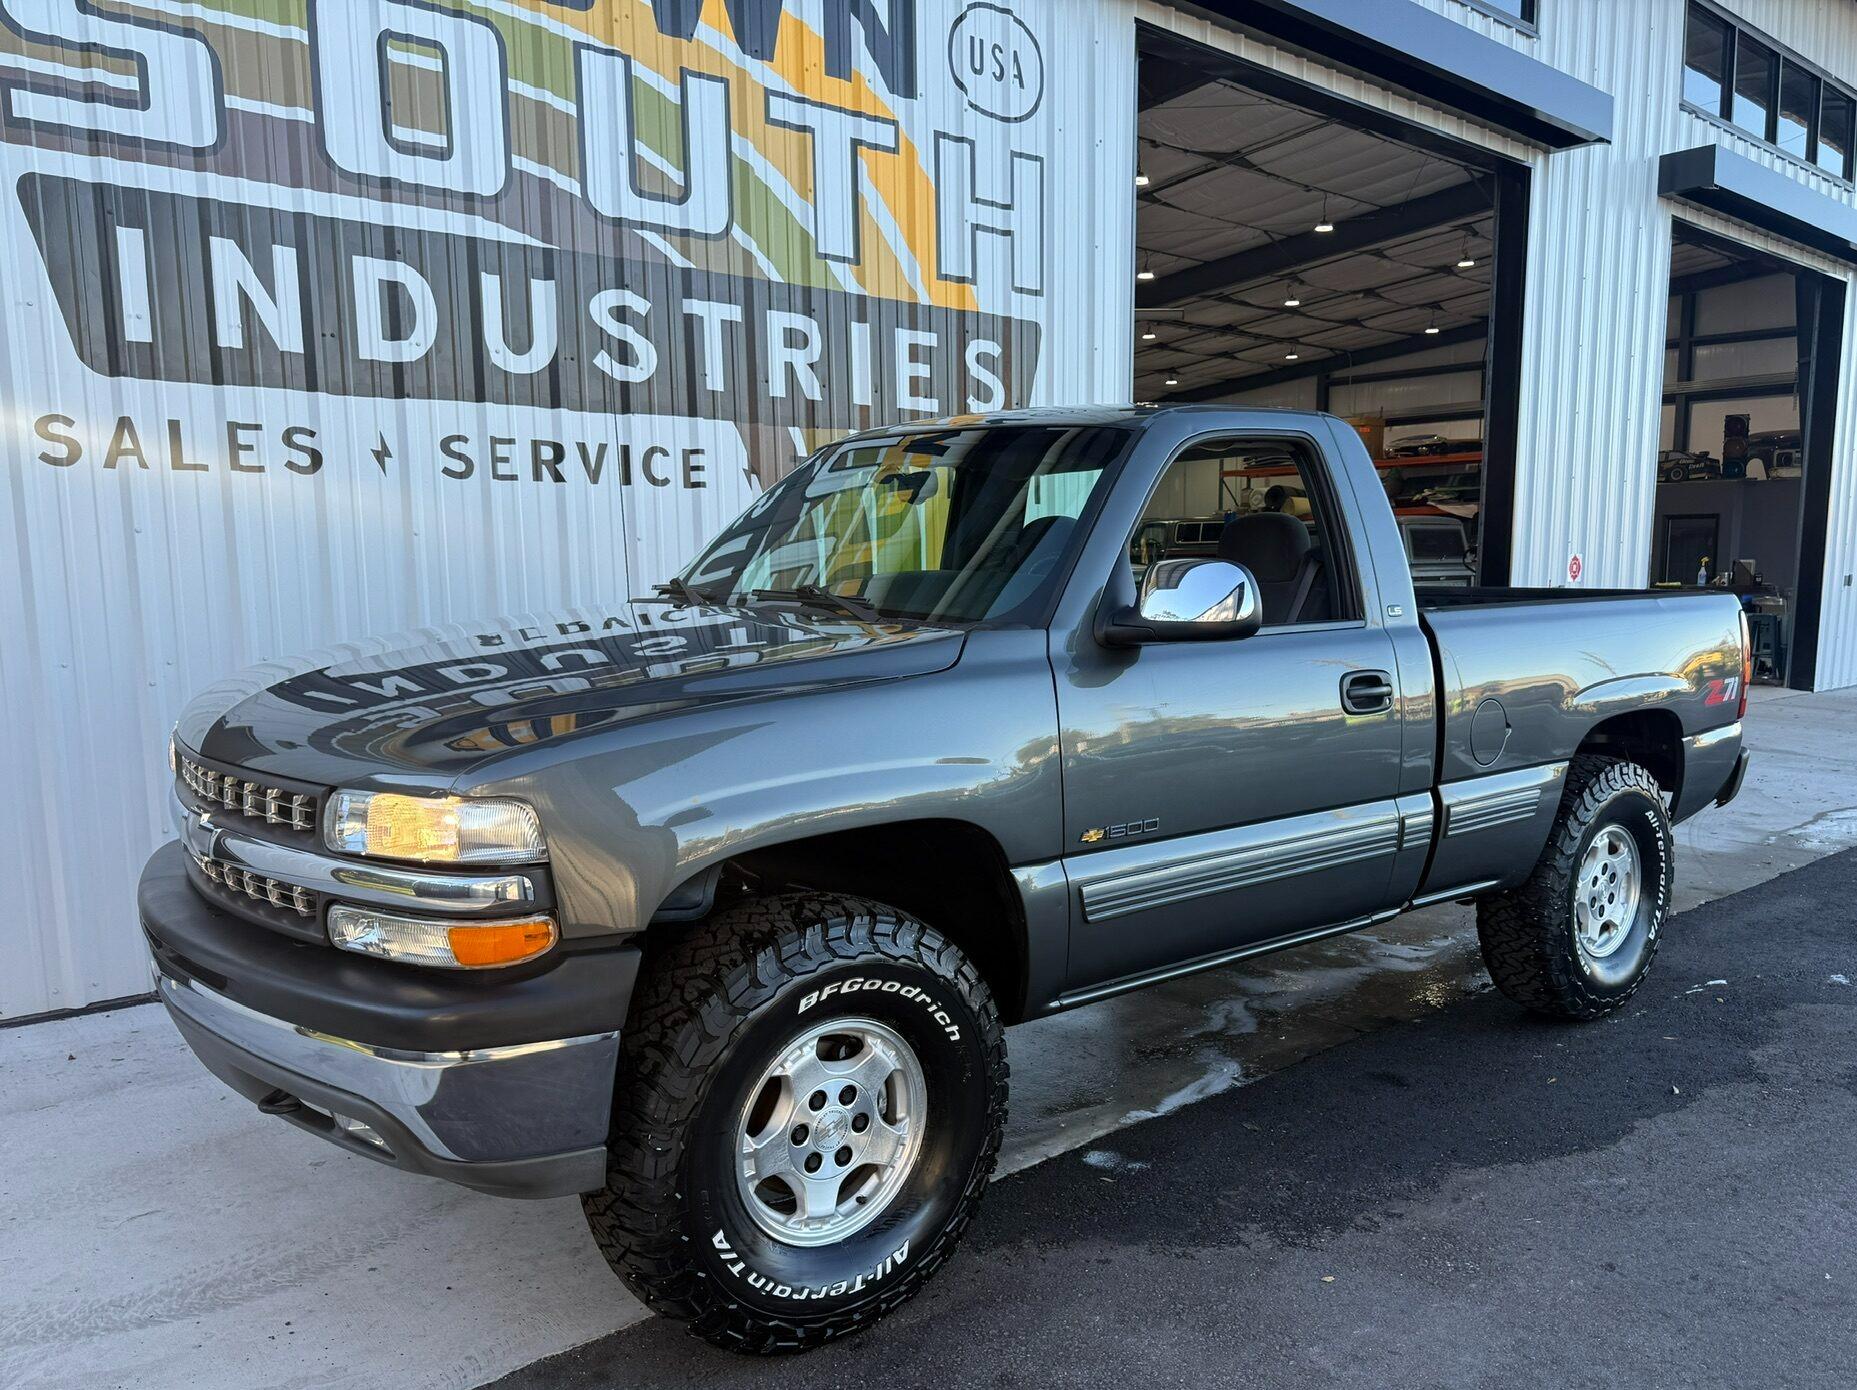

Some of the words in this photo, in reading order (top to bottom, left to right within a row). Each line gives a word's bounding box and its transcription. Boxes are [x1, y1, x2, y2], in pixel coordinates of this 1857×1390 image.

[969, 35, 1026, 91] USA
[0, 0, 1044, 297] SOUTH
[116, 226, 1006, 413] INDUSTRIES
[34, 413, 324, 475] SALES
[439, 434, 707, 489] SERVICE
[1705, 676, 1739, 706] Z71
[1106, 818, 1159, 839] 1500
[1645, 810, 1667, 907] All-Terrain
[797, 977, 961, 1043] BFGoodrich
[712, 1229, 746, 1278] T/A
[747, 1239, 910, 1300] All-Terrain
